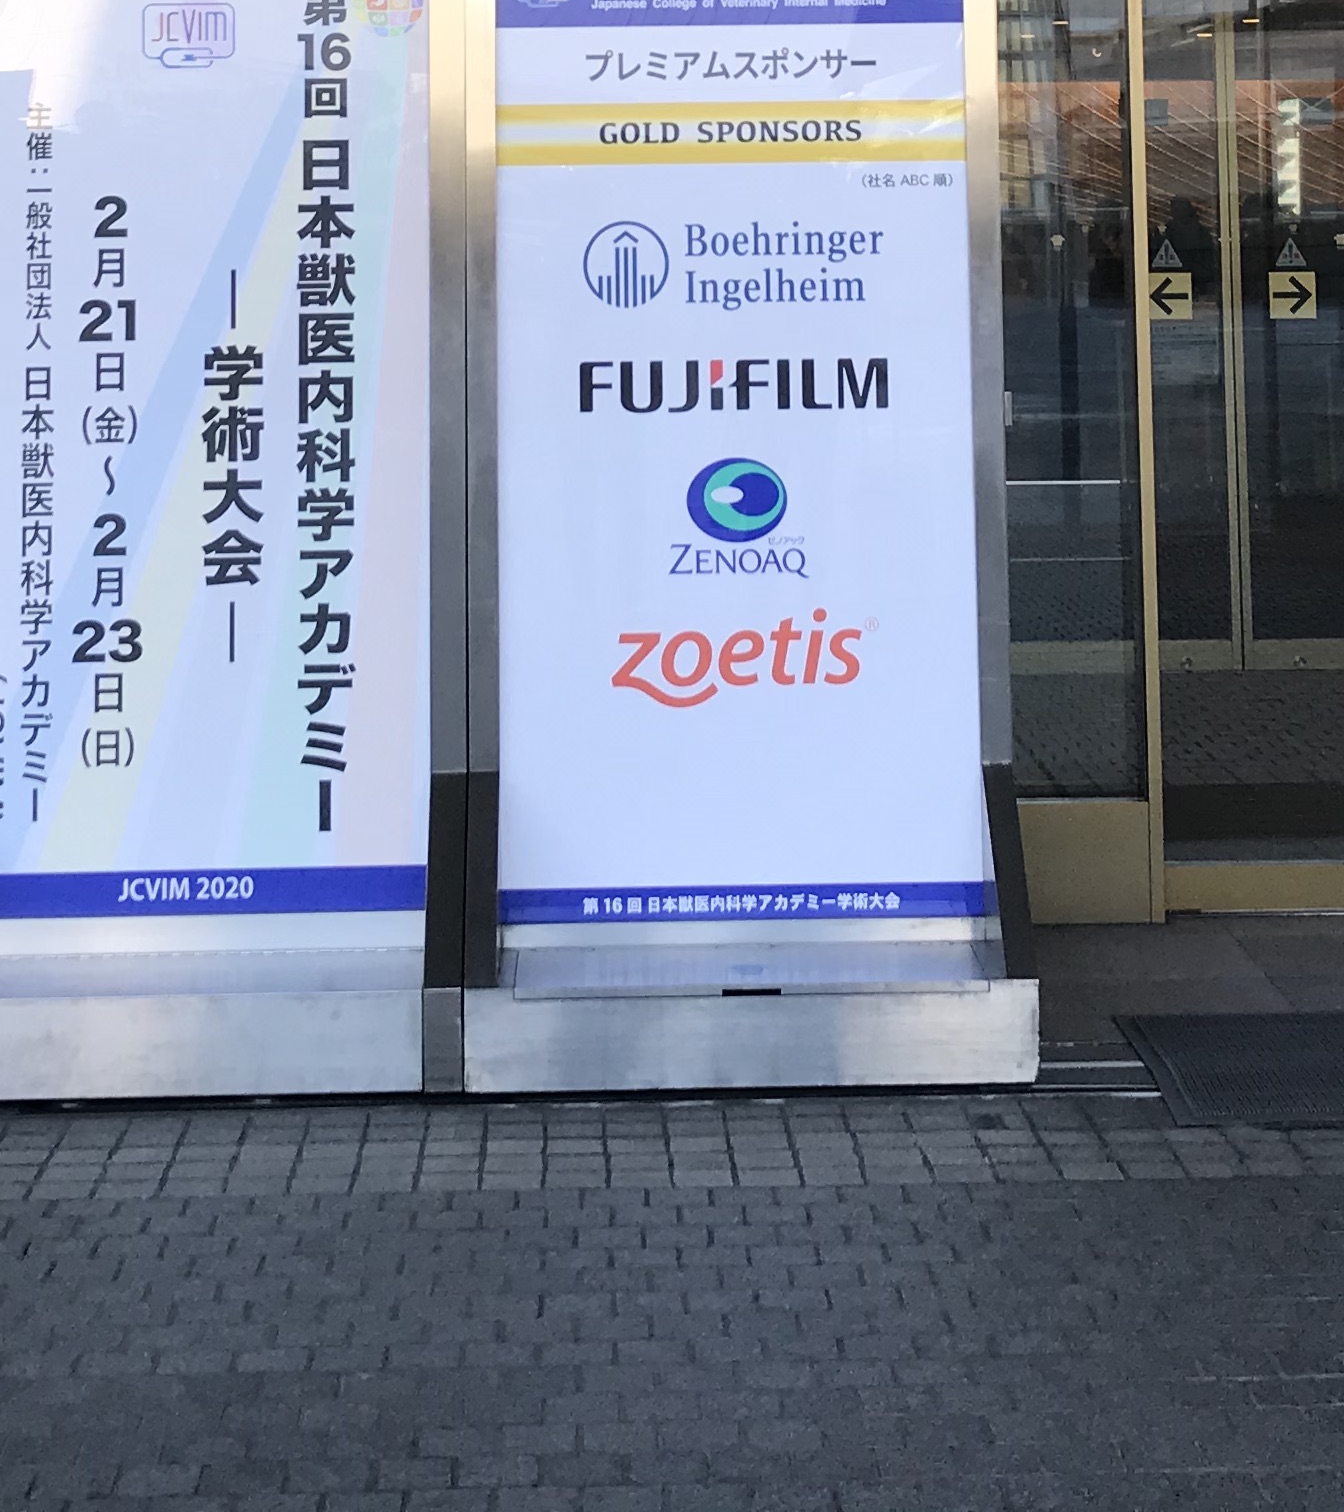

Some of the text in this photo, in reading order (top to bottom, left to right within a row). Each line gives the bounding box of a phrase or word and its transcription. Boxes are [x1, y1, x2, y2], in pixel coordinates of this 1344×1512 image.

[151, 9, 228, 43] JCVIM
[586, 48, 877, 81] プレミアムスポンサー
[599, 119, 863, 145] GOLD SPONSORS
[684, 221, 885, 262] Boehringer
[684, 268, 867, 311] Ingelheim
[579, 357, 889, 414] FUJIFILM
[668, 544, 810, 579] ZENOAQ
[118, 874, 255, 902] JCVIM 2020
